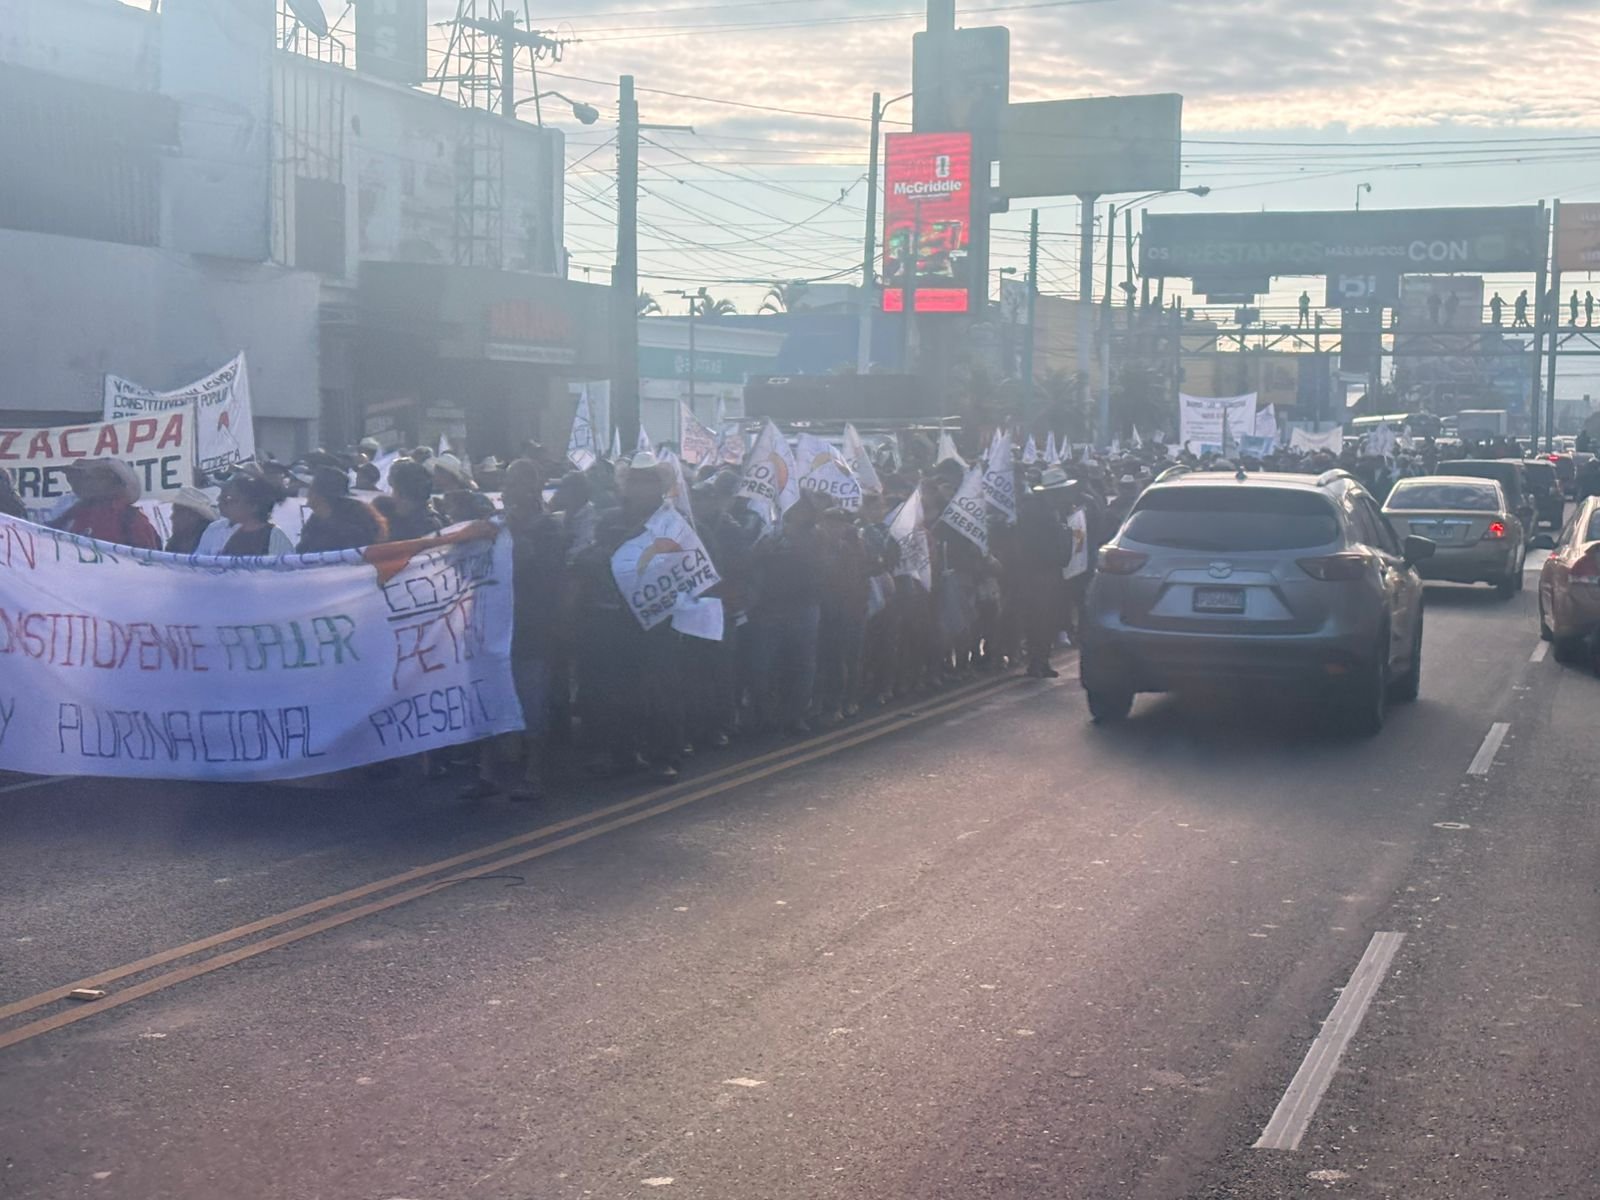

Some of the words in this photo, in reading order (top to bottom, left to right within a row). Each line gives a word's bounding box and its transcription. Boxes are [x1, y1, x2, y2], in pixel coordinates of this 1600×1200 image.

[894, 180, 962, 195] McGriddle
[1408, 239, 1468, 262] CON
[0, 413, 183, 459] ZACAPA
[798, 475, 860, 495] CODECA
[632, 547, 706, 609] CODECA
[639, 565, 714, 626] PRESENTE
[58, 702, 328, 763] PLURINACIONAL
